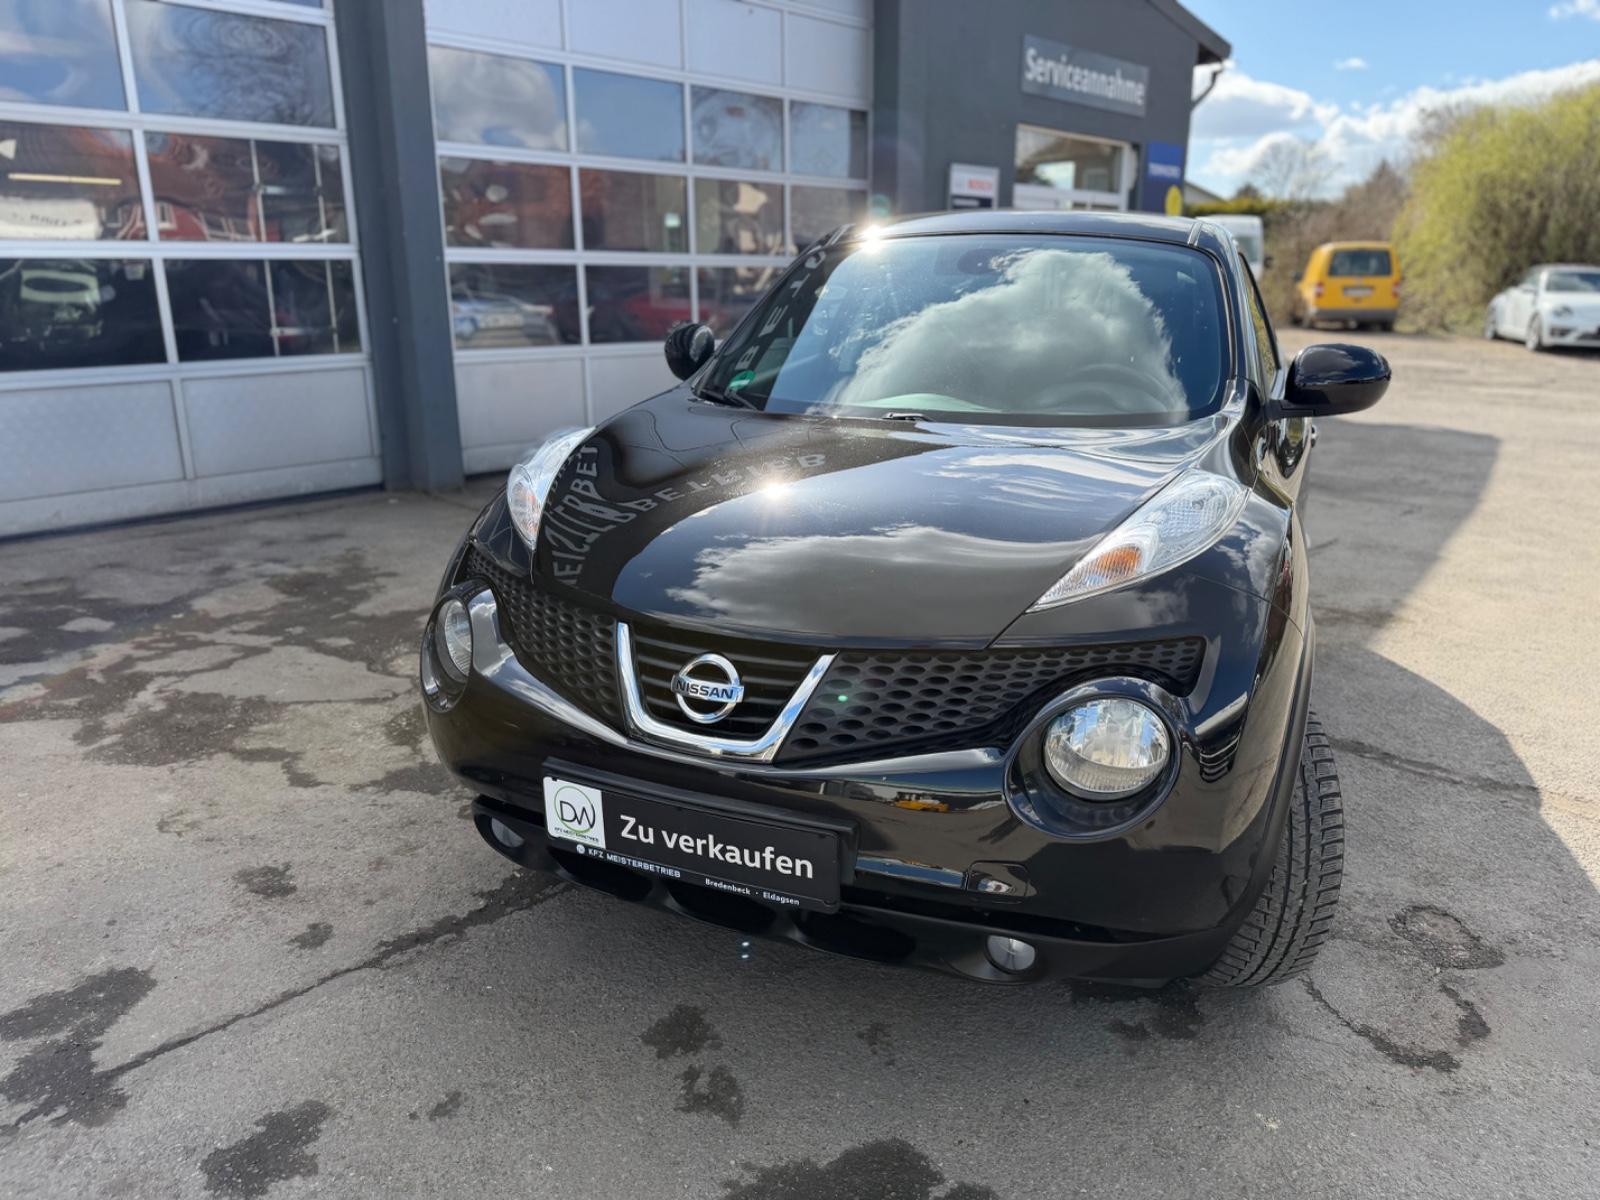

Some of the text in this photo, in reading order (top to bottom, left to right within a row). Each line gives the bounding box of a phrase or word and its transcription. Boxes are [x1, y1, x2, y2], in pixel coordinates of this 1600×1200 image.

[1024, 47, 1145, 105] Serviceannahme
[676, 679, 734, 700] NISSAN
[620, 814, 654, 845] Zu
[661, 829, 813, 879] verkaufen
[588, 848, 681, 878] KFZ MEISTERBETRIEB
[705, 877, 801, 906] Bredenbeck Eldagsen
